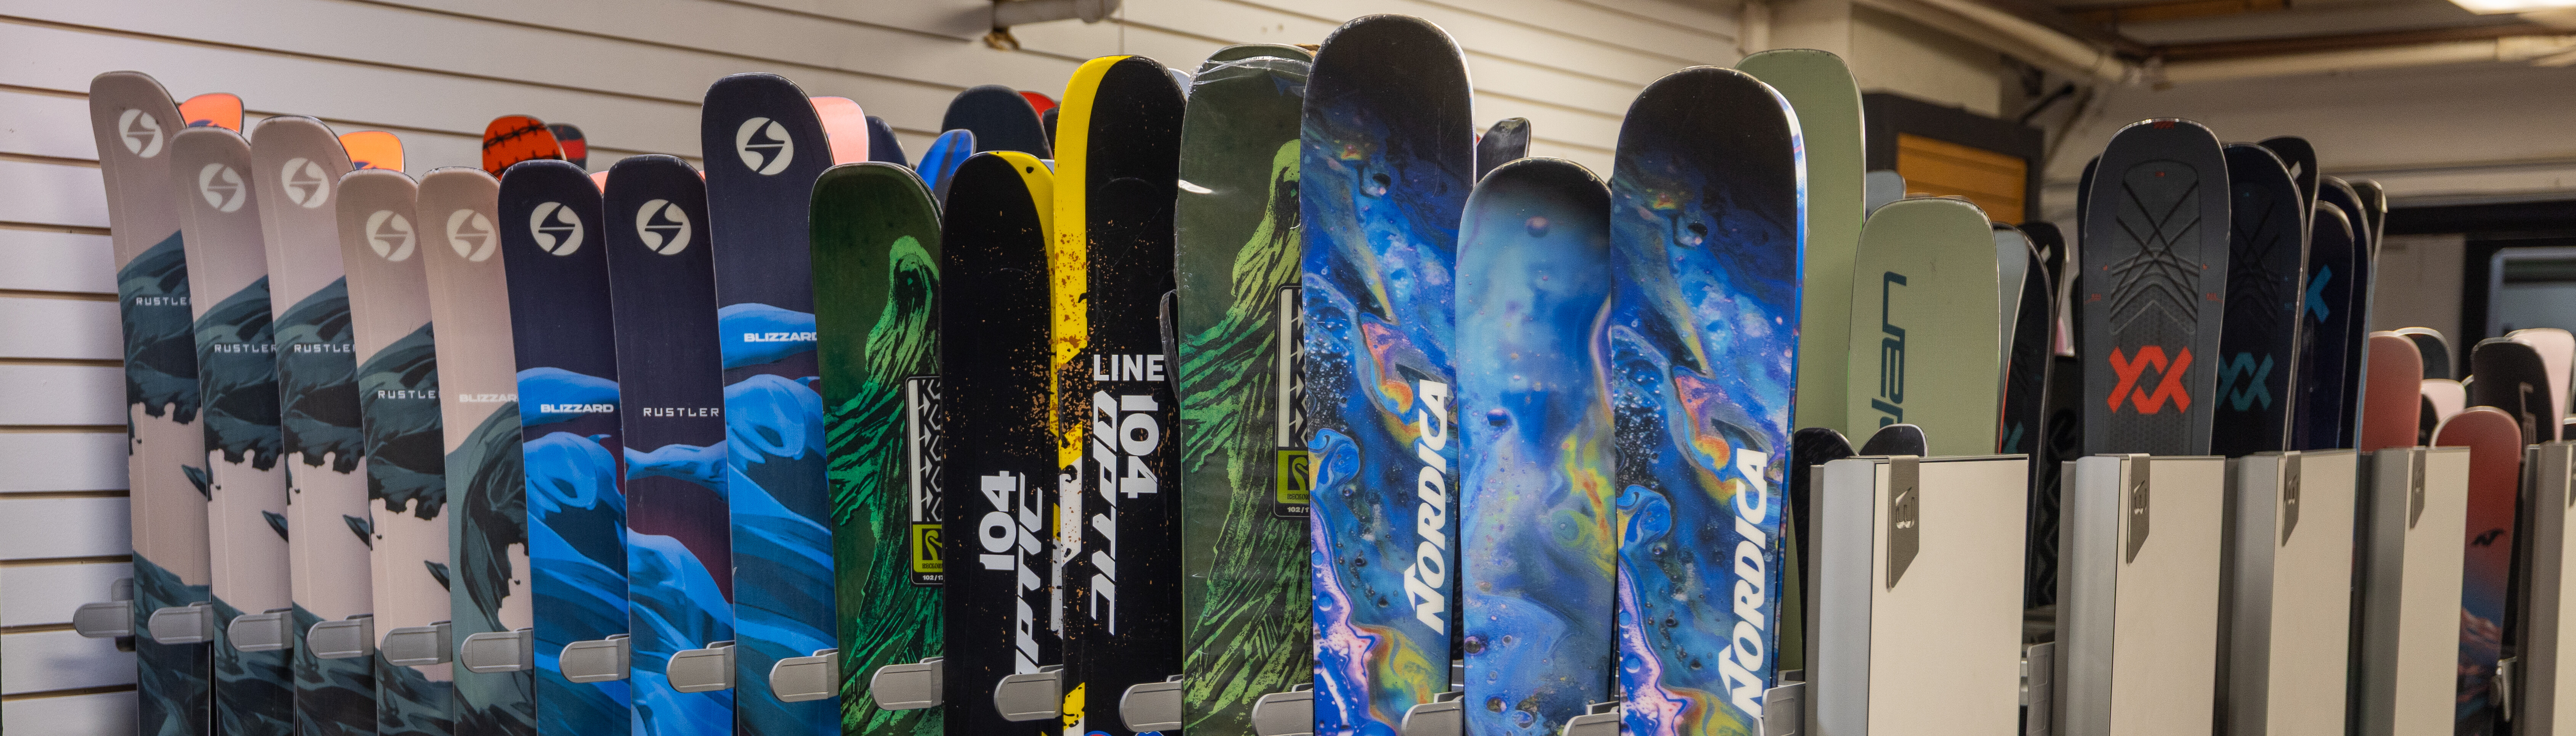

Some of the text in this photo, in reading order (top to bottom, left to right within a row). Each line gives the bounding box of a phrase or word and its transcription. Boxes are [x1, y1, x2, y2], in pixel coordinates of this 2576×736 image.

[136, 297, 191, 306] RUSTLE
[1094, 354, 1164, 381] LINE
[1871, 271, 1907, 429] lan
[378, 390, 440, 399] RUSTLE
[459, 394, 519, 402] BLIZZAR
[540, 404, 614, 413] BLIZZARD
[643, 407, 719, 417] RUSTLER
[1120, 395, 1159, 498] 104
[979, 470, 1016, 570] 104
[1091, 390, 1117, 636] OPTIC
[1404, 379, 1448, 636] NORDICA
[1718, 448, 1767, 717] NORDICA
